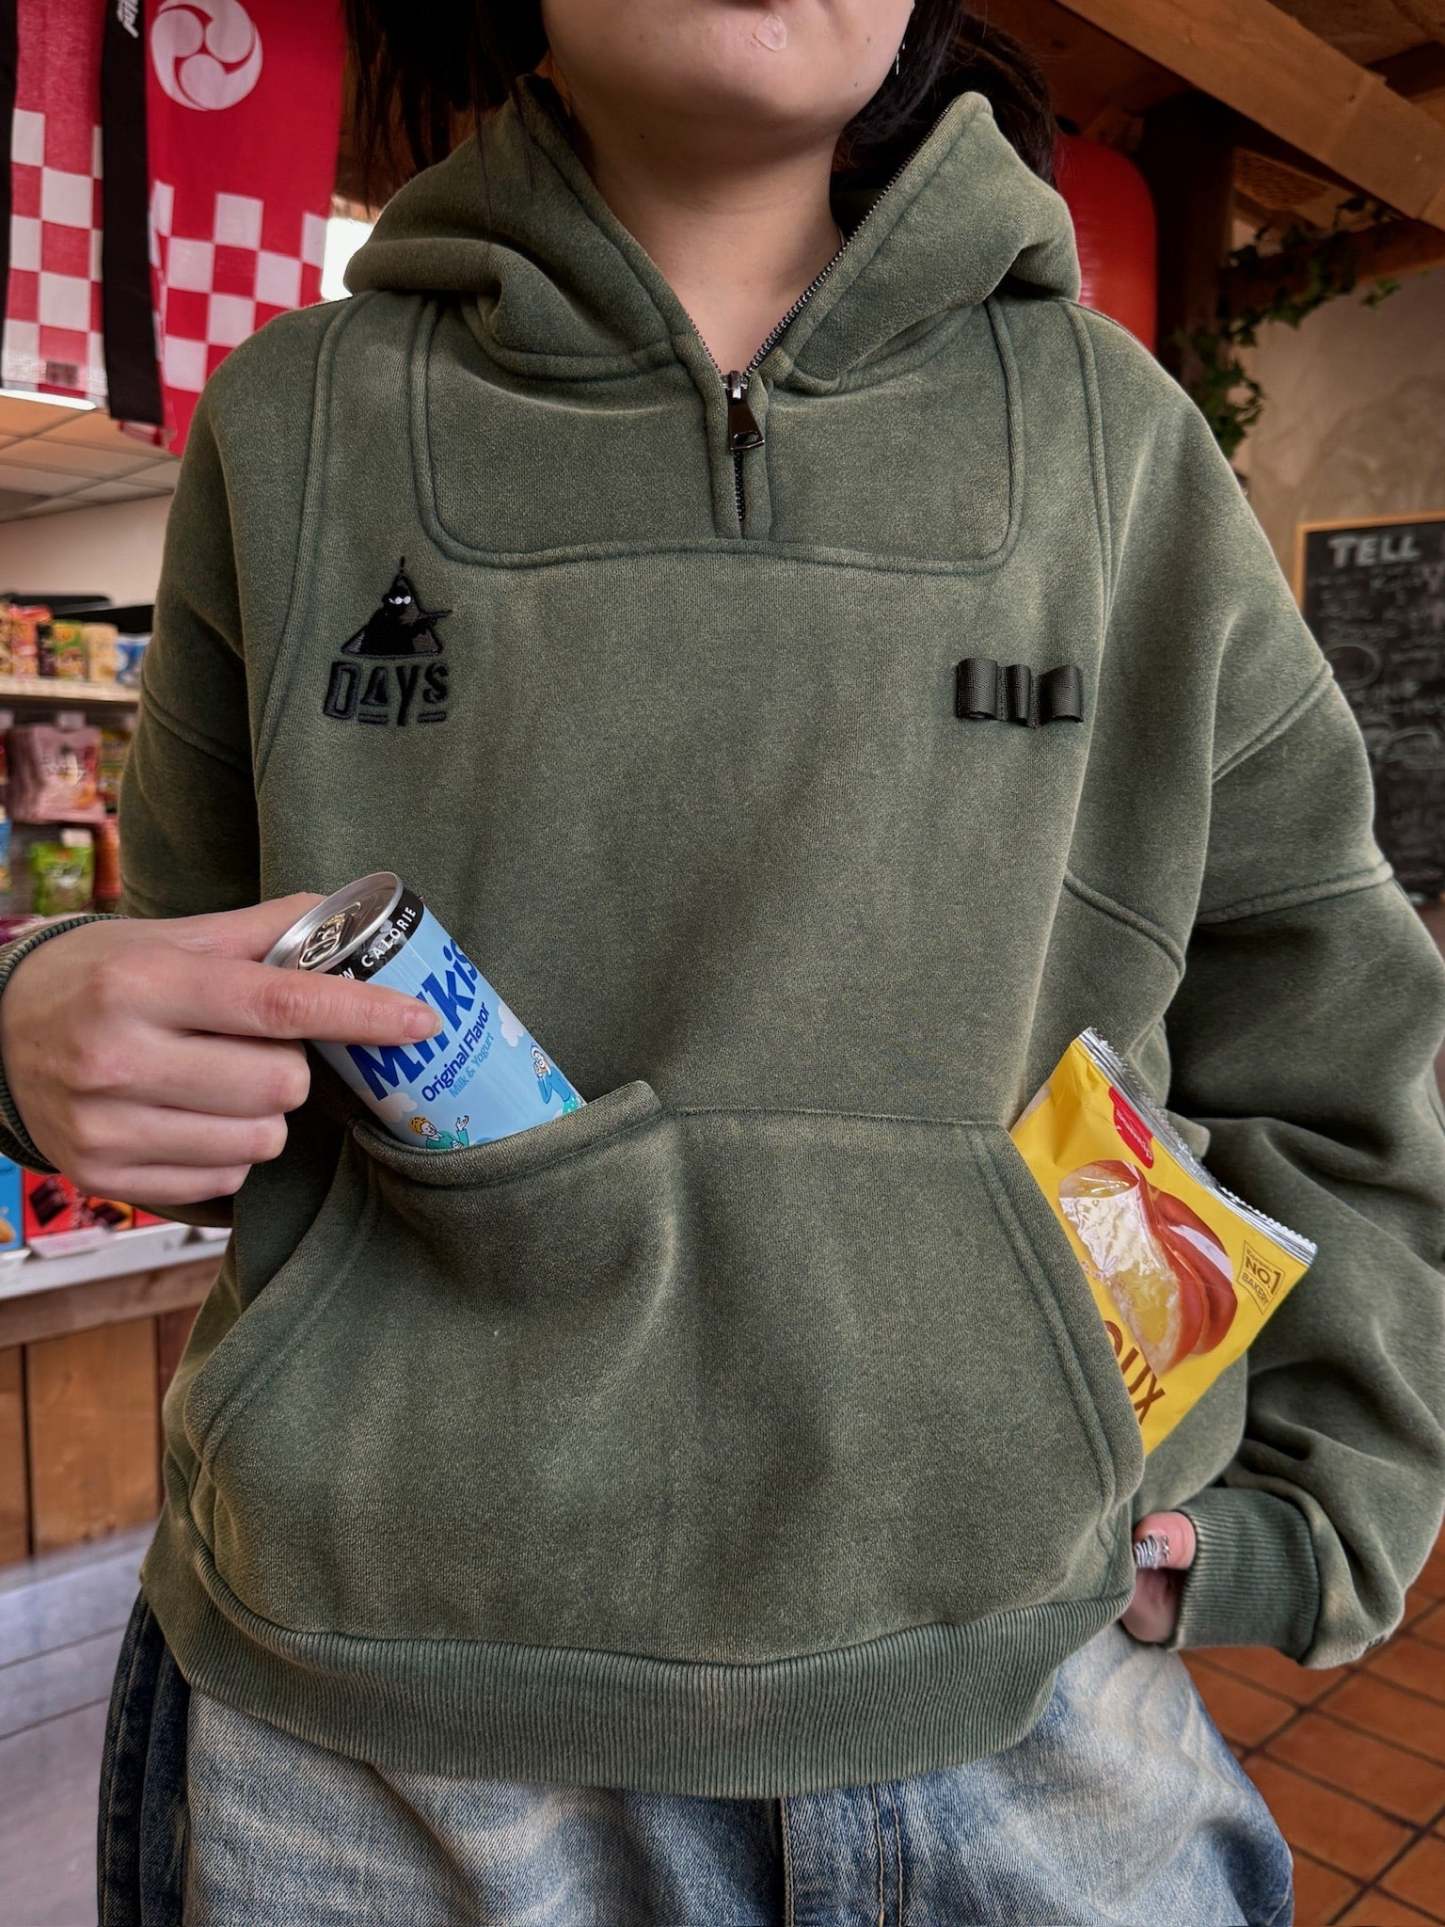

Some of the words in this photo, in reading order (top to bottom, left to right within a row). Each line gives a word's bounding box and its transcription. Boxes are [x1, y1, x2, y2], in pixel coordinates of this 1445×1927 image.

[1328, 534, 1421, 568] TELL
[361, 906, 417, 968] CALORIE
[421, 1043, 470, 1102] Original
[463, 1001, 490, 1053] Flavor
